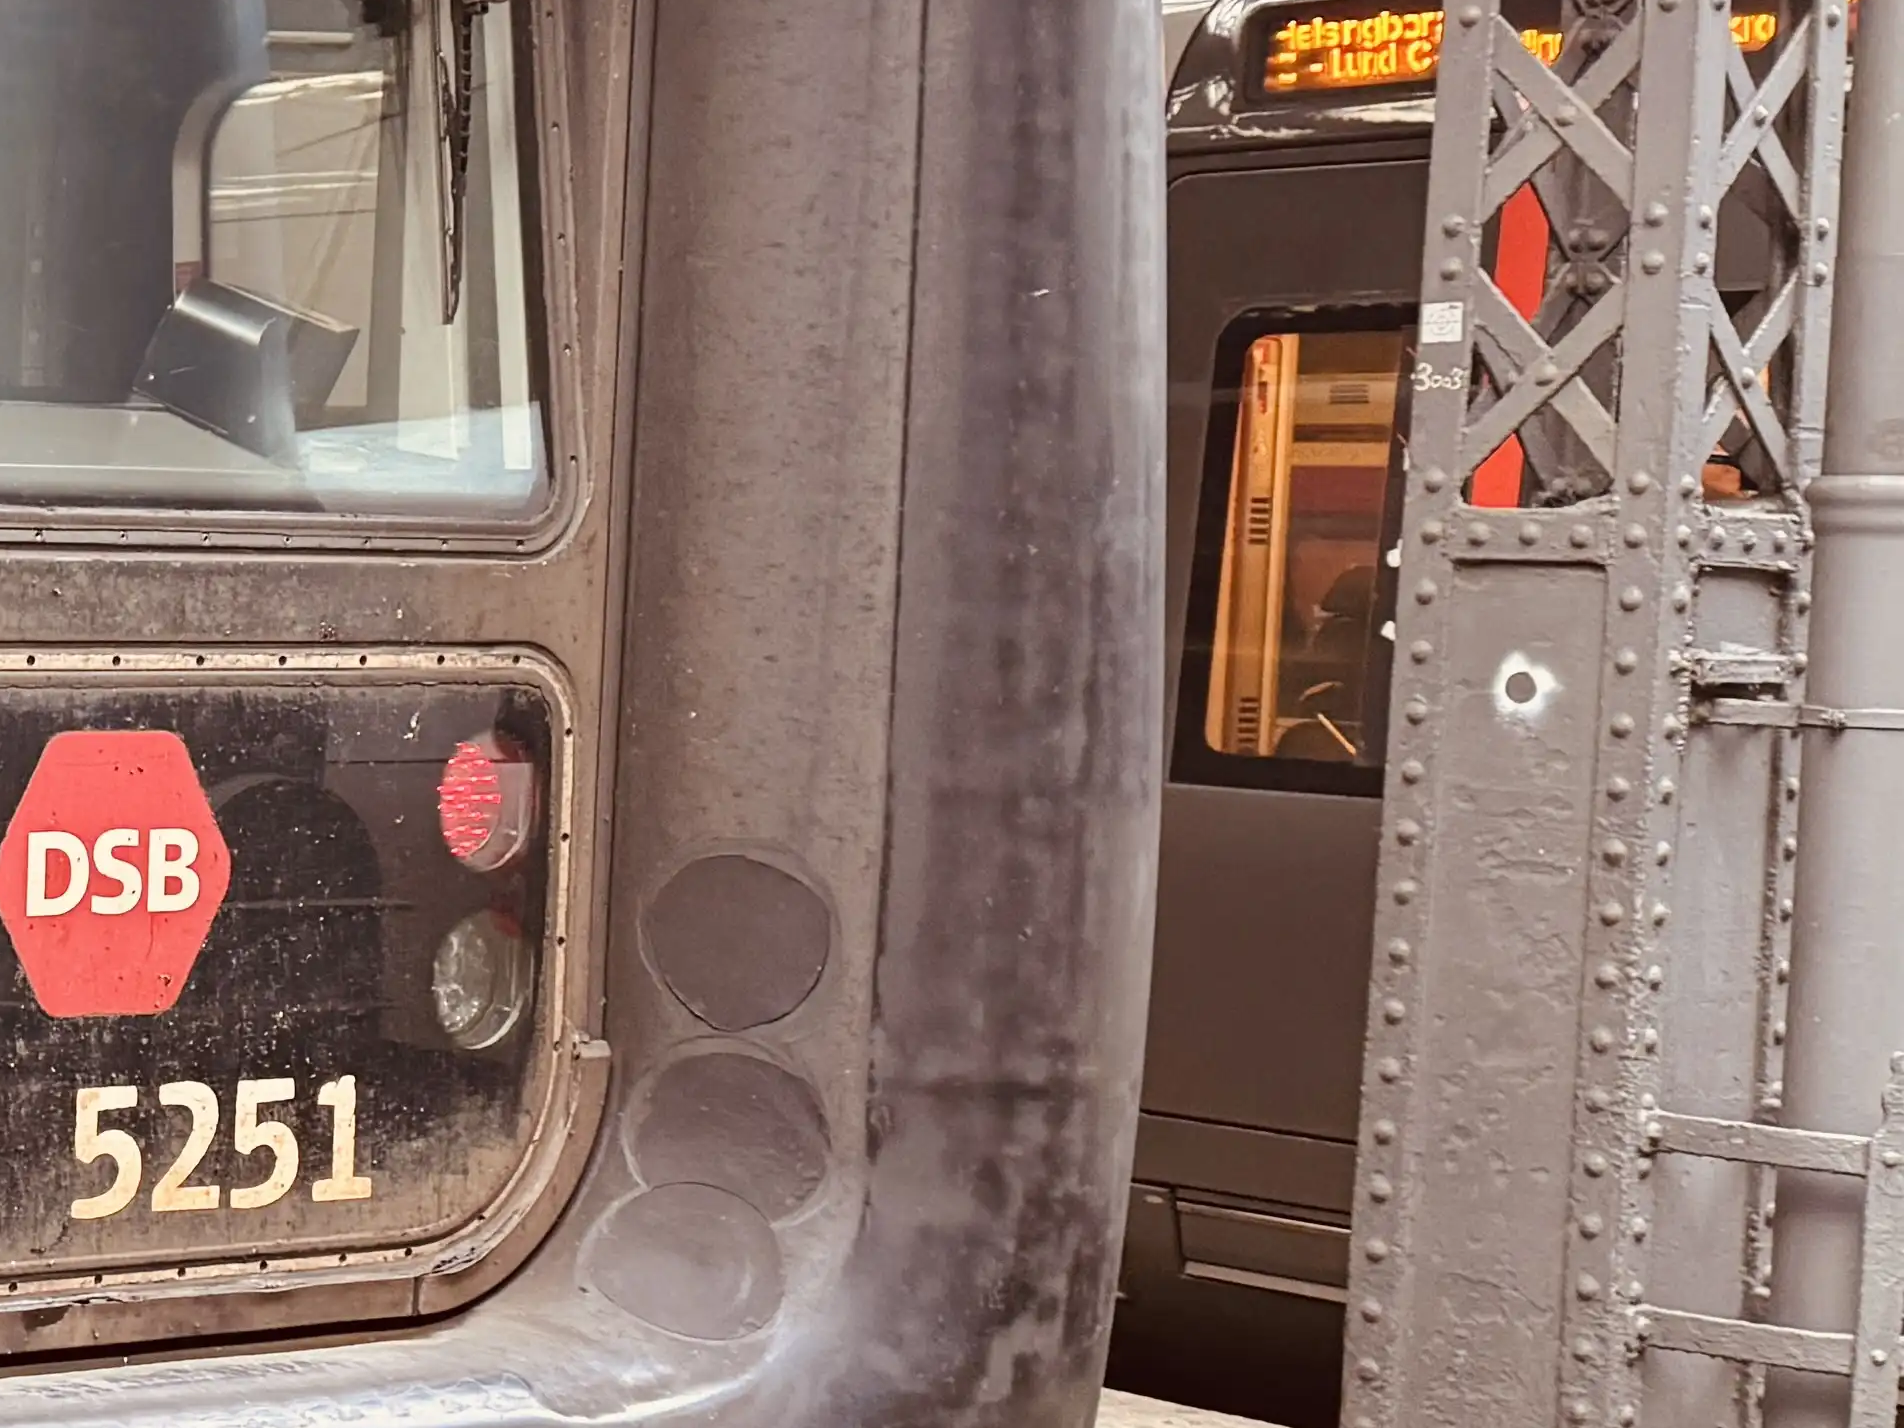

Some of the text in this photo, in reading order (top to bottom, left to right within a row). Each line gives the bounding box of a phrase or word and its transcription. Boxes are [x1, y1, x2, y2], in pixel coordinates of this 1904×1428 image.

[1333, 43, 1397, 78] Lund
[25, 827, 201, 917] DSB
[68, 1074, 374, 1220] 5251
